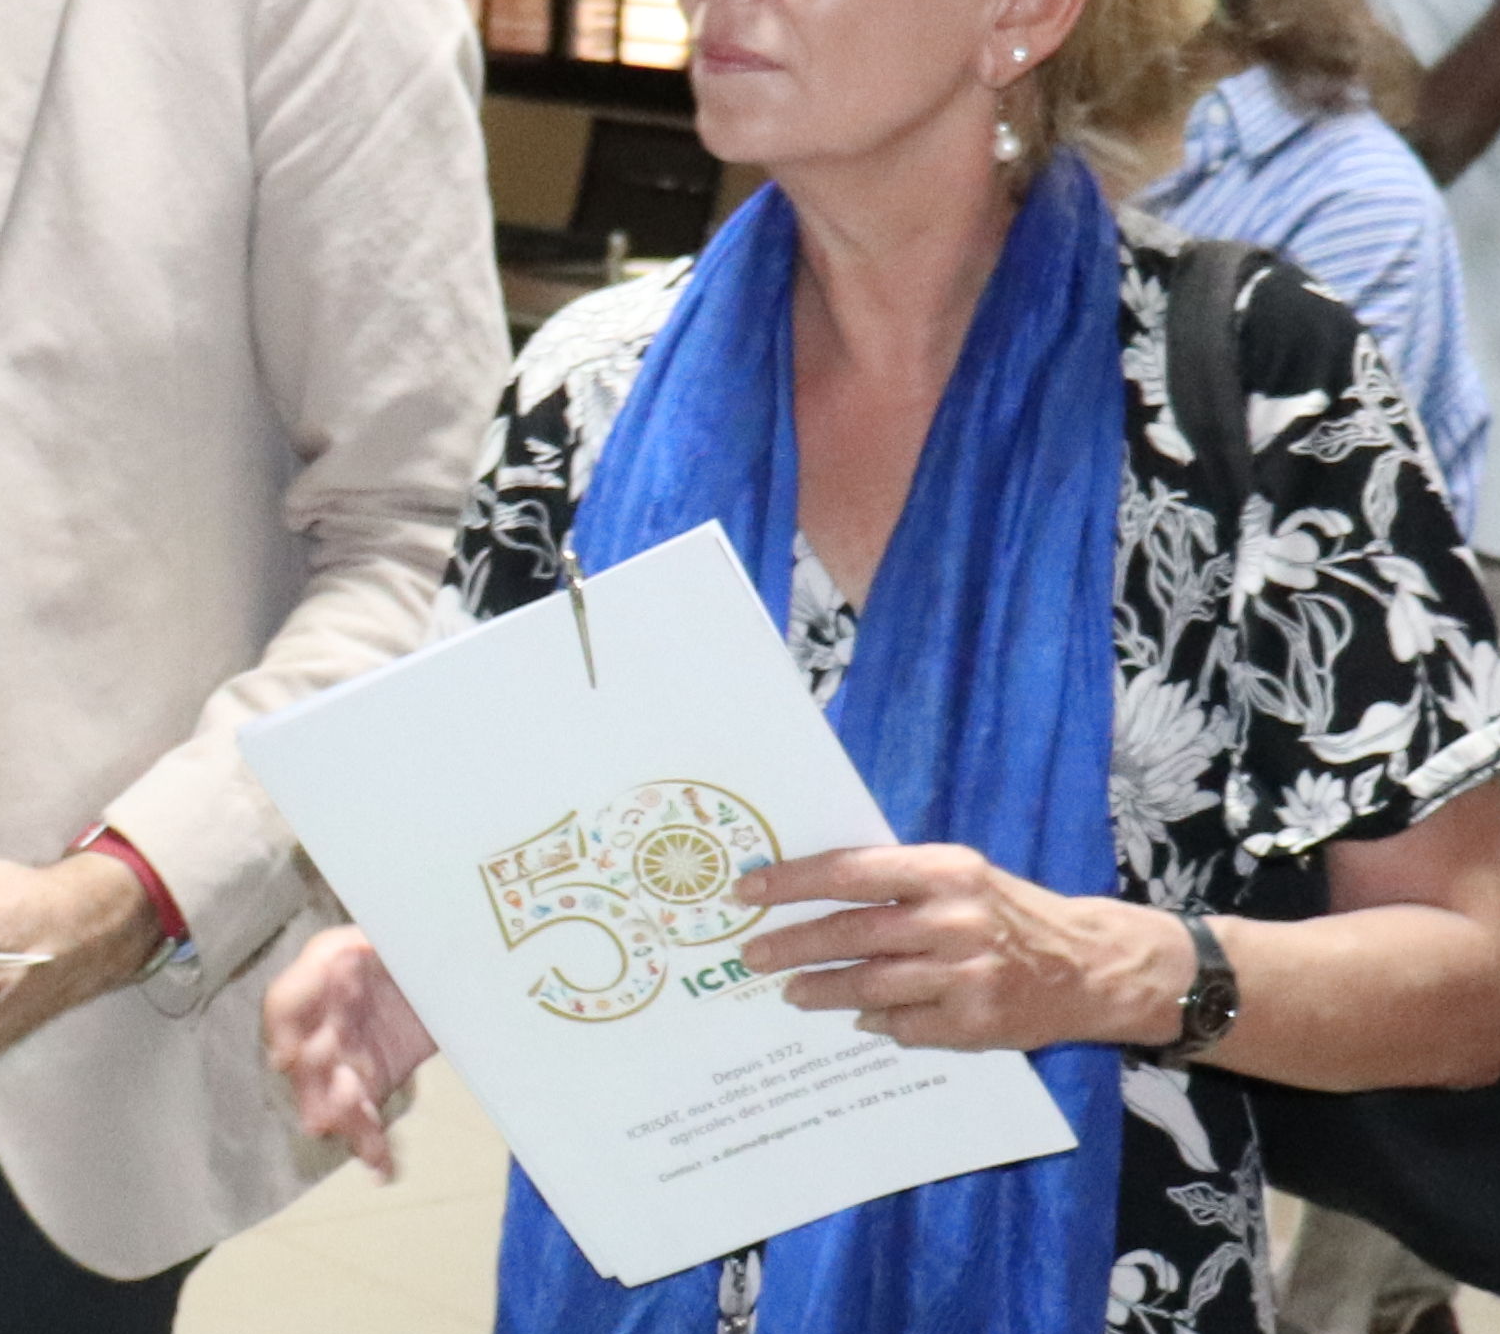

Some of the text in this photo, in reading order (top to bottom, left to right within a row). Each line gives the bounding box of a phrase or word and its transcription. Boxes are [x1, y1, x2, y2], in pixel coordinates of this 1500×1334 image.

[680, 957, 752, 998] ICR
[688, 1101, 716, 1117] aux
[760, 1071, 787, 1089] des
[789, 1056, 832, 1081] petits
[712, 1041, 804, 1085] Depuis 1972
[670, 1115, 736, 1146] agricoles
[738, 1102, 766, 1119] des
[768, 1087, 810, 1109] zones
